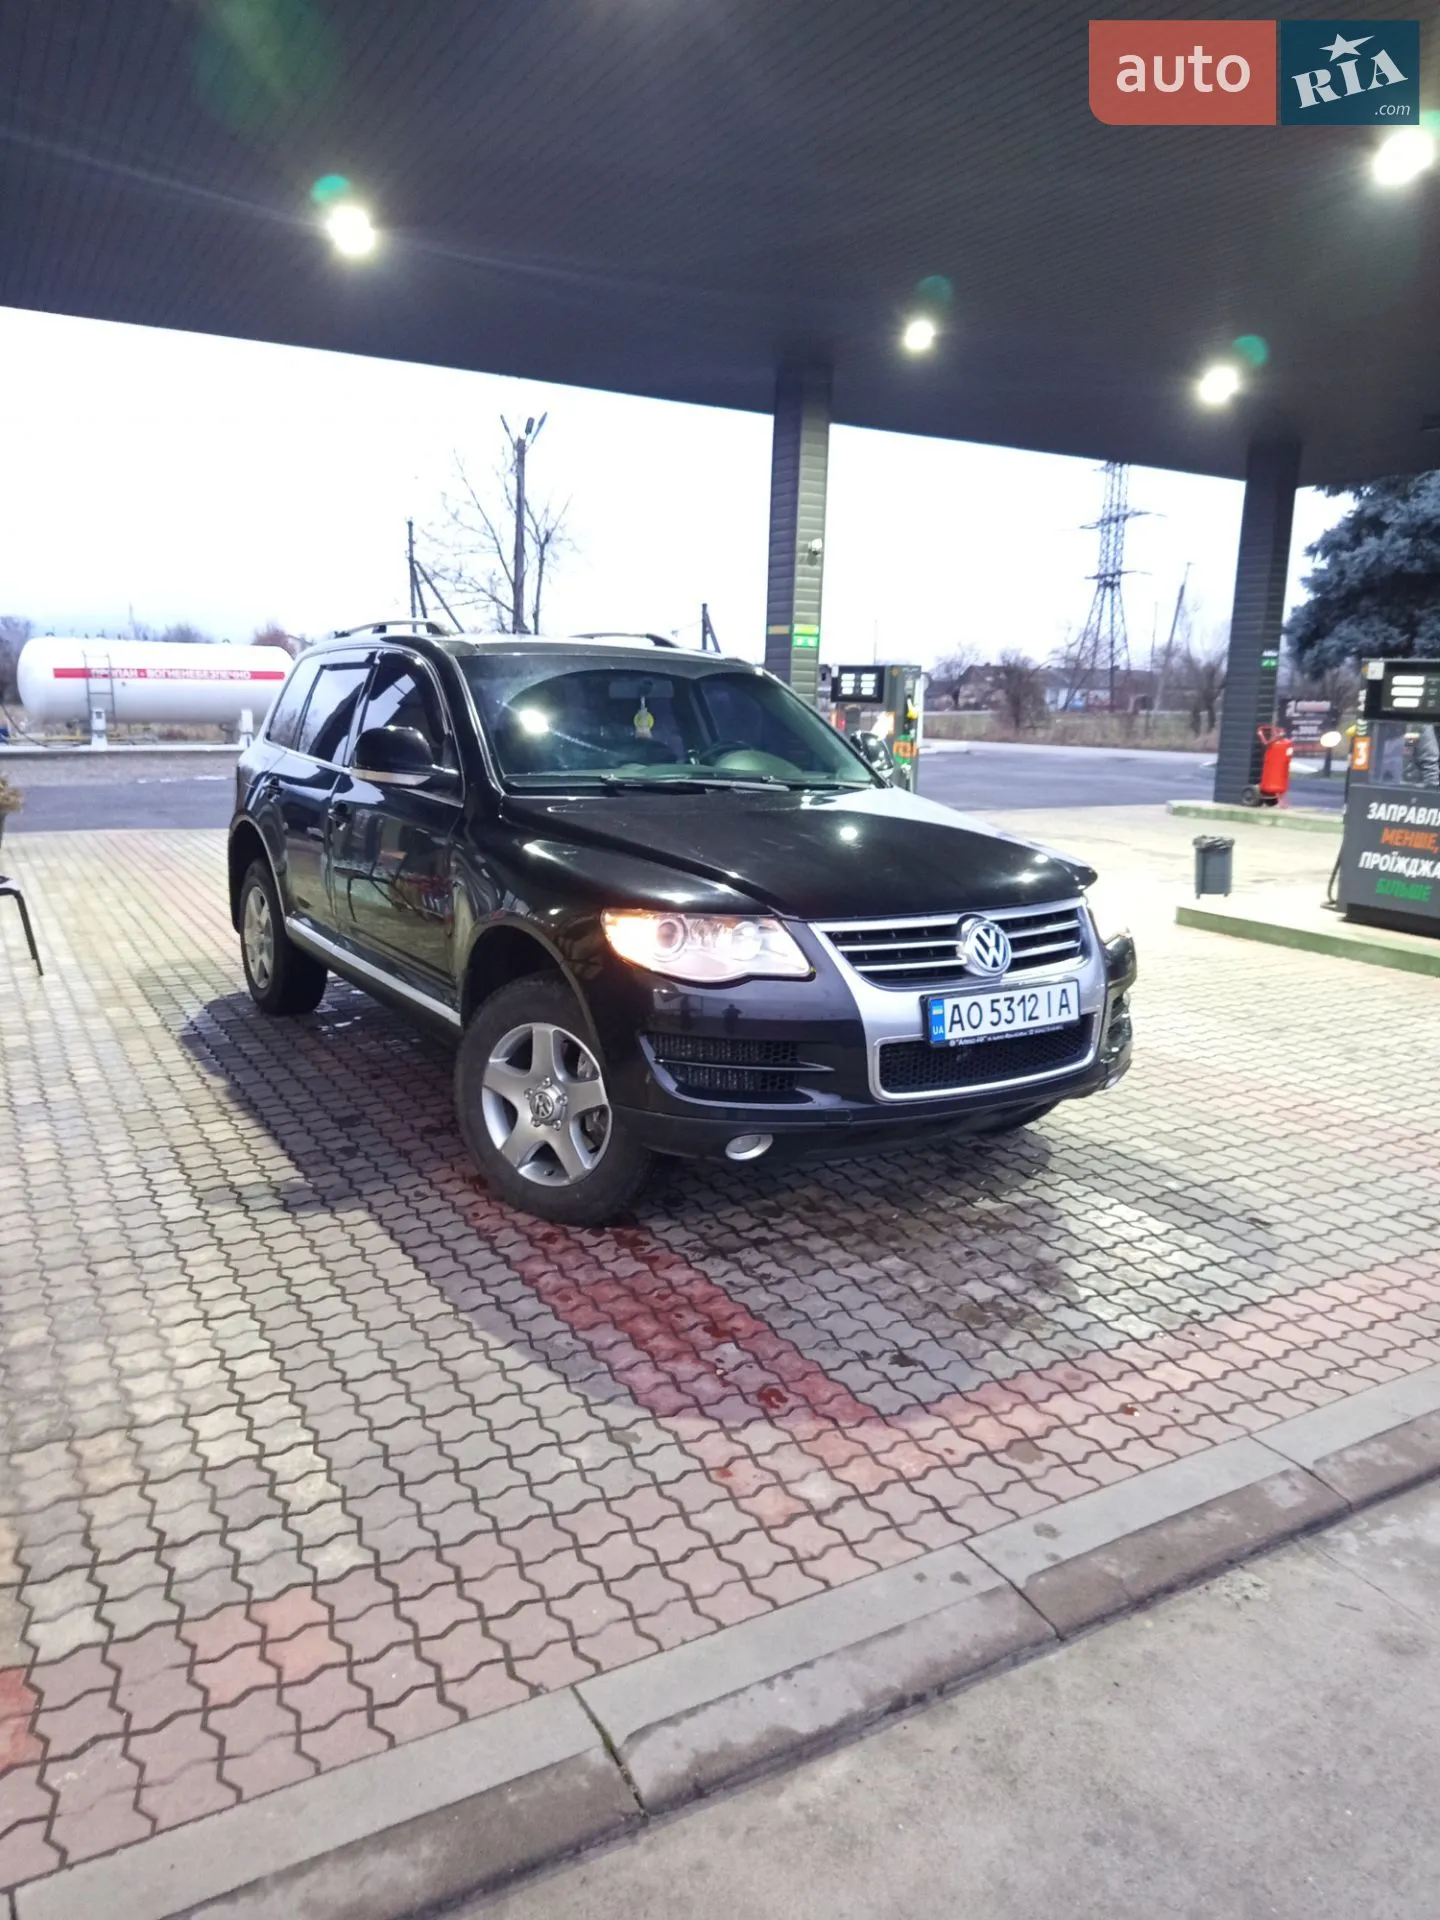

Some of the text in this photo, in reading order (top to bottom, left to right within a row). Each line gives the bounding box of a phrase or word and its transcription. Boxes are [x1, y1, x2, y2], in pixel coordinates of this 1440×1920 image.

[1354, 741, 1367, 766] 3
[949, 1001, 983, 1033] AO
[990, 993, 1039, 1027] 5312
[932, 1025, 945, 1035] UA
